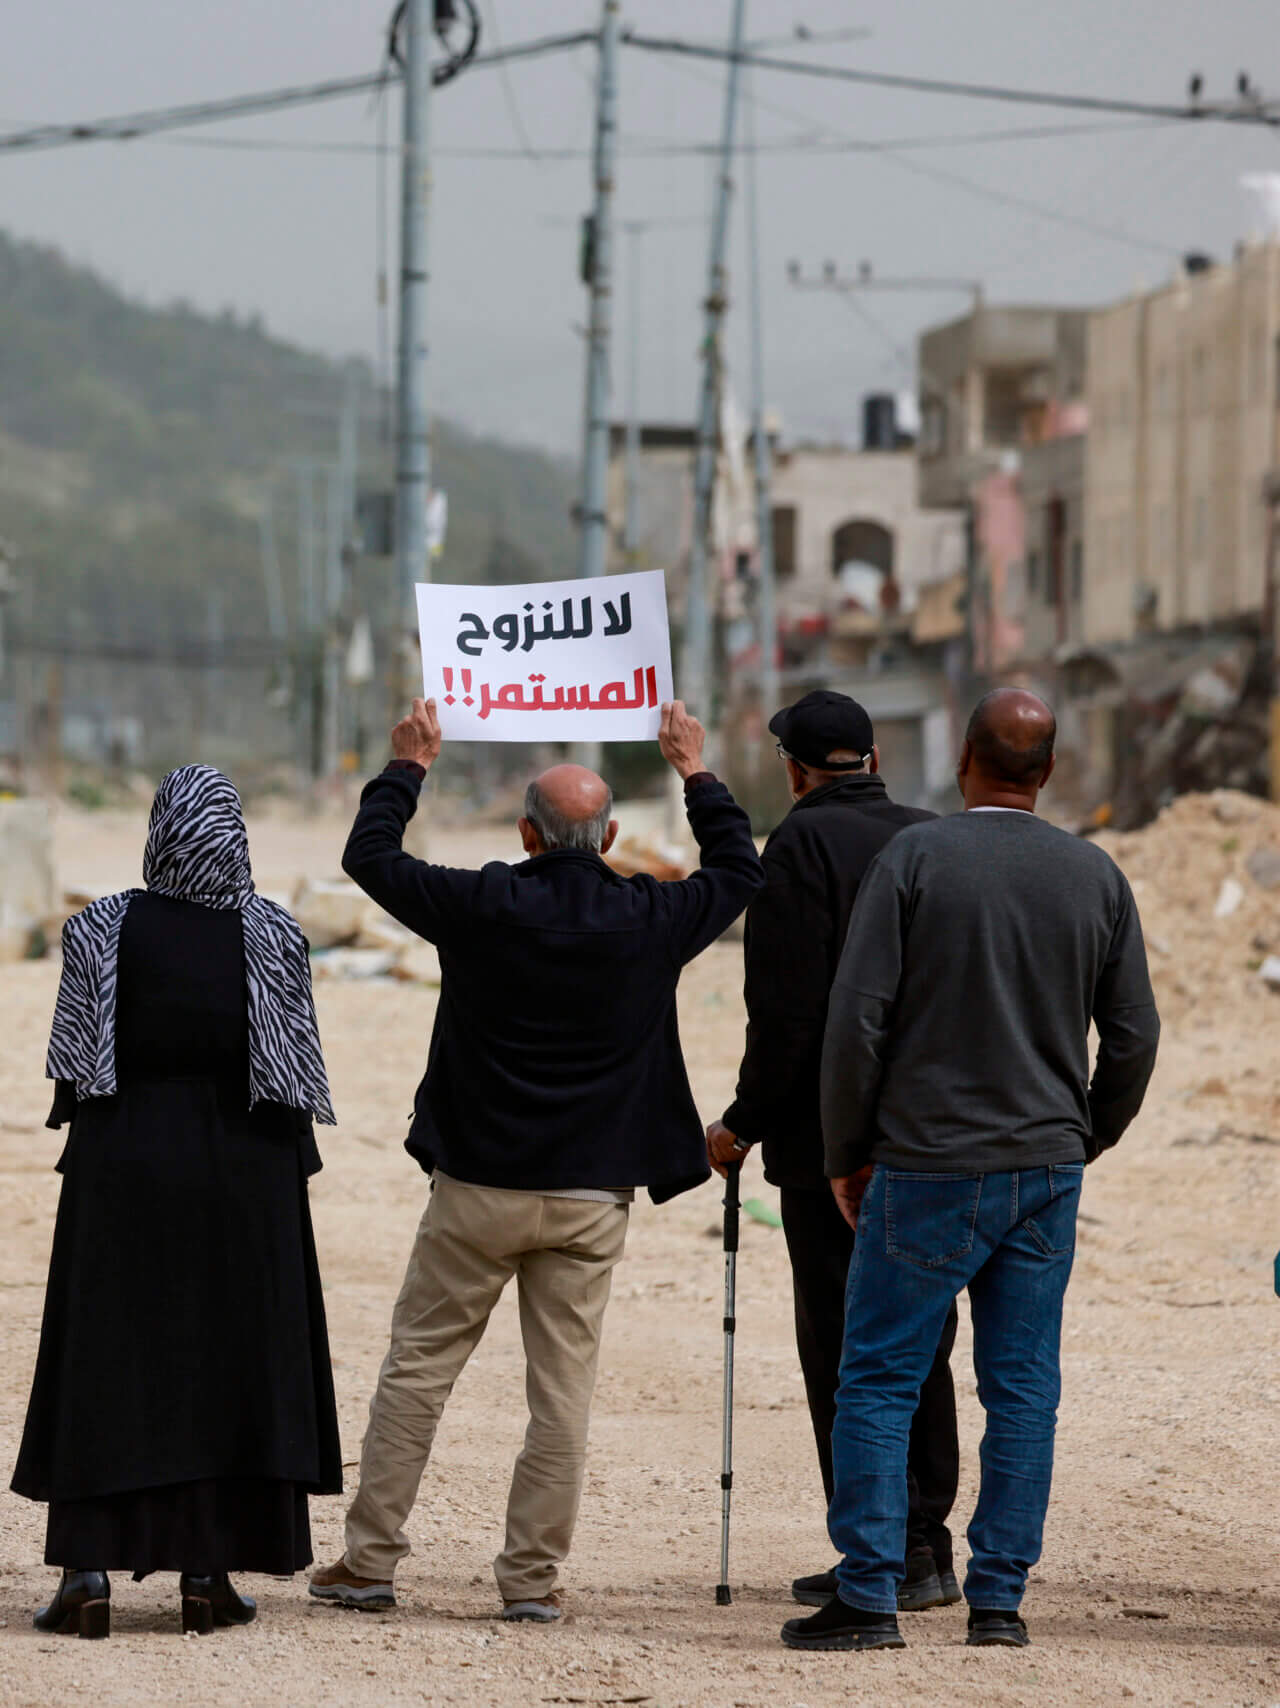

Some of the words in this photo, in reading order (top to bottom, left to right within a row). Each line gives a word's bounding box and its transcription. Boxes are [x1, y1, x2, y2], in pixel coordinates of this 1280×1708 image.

[456, 595, 593, 656] للنزوح
[602, 591, 632, 636] لا
[442, 665, 659, 720] المستمر!!
